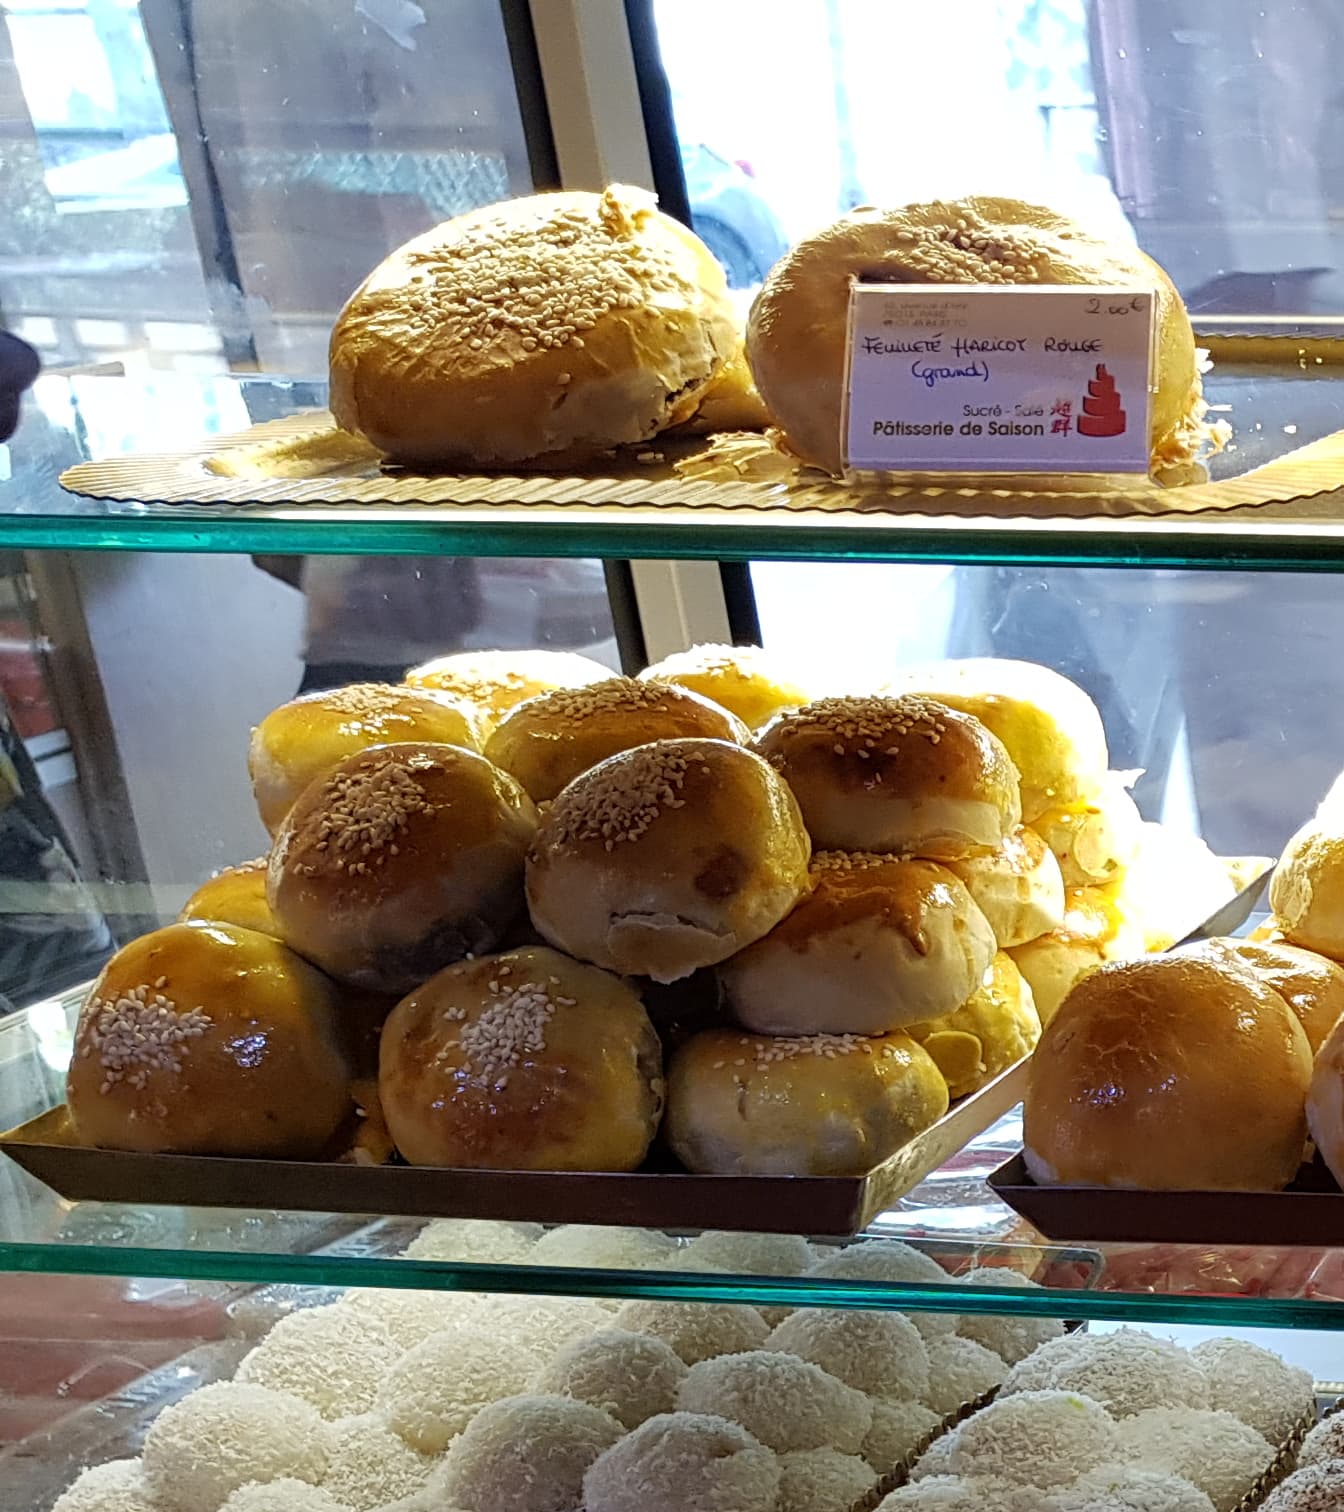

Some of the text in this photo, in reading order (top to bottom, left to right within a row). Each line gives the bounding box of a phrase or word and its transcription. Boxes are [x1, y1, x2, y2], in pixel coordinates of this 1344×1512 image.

[952, 337, 1028, 357] HARICOT
[1044, 338, 1103, 353] ROUGE
[911, 361, 989, 387] (grand)
[963, 404, 1001, 417] Sucré
[873, 420, 1044, 437] Pâtisserie de Saison
